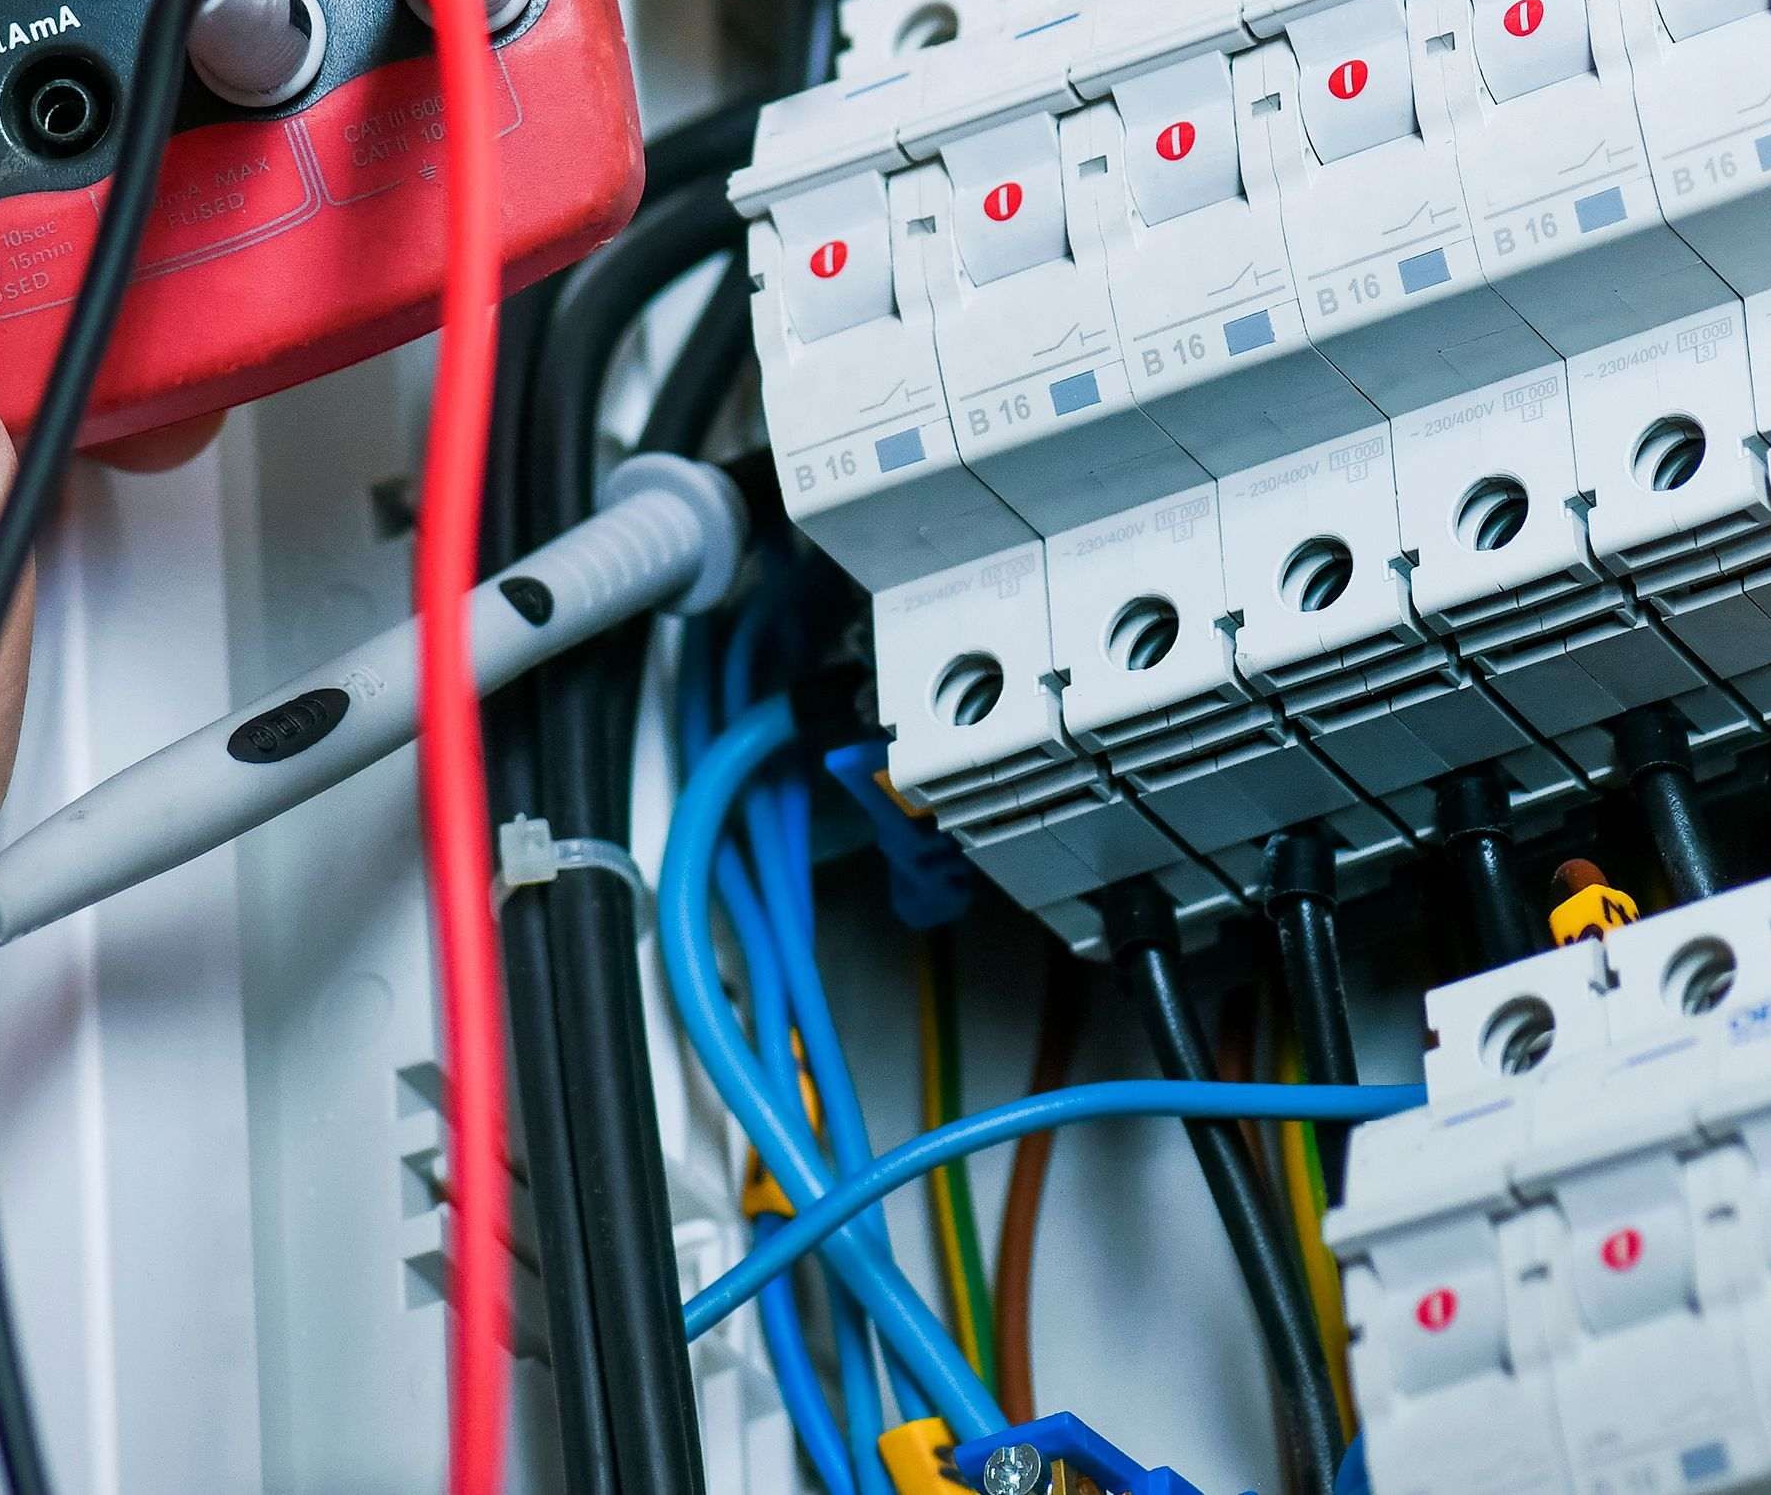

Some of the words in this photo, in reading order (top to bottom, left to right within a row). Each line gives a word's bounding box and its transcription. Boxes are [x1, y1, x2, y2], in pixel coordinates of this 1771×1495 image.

[214, 156, 271, 186] MAX
[168, 192, 245, 228] FUSED
[0, 221, 58, 248] 10sec
[1492, 227, 1516, 256] B
[1525, 212, 1558, 244] 16
[8, 241, 74, 271] 15min
[1316, 287, 1339, 316] B
[1347, 273, 1381, 305] 16
[1700, 321, 1729, 341] 000
[1141, 348, 1165, 377] B
[1173, 333, 1206, 365] 16
[1598, 341, 1670, 379] 230/400V
[1527, 381, 1556, 401] 000
[968, 408, 990, 436] B
[998, 394, 1031, 425] 16
[1423, 401, 1494, 438] 230/400V
[1353, 440, 1382, 460] 000
[795, 464, 817, 493] B
[825, 450, 857, 481] 16
[1250, 461, 1320, 498] 230/400V
